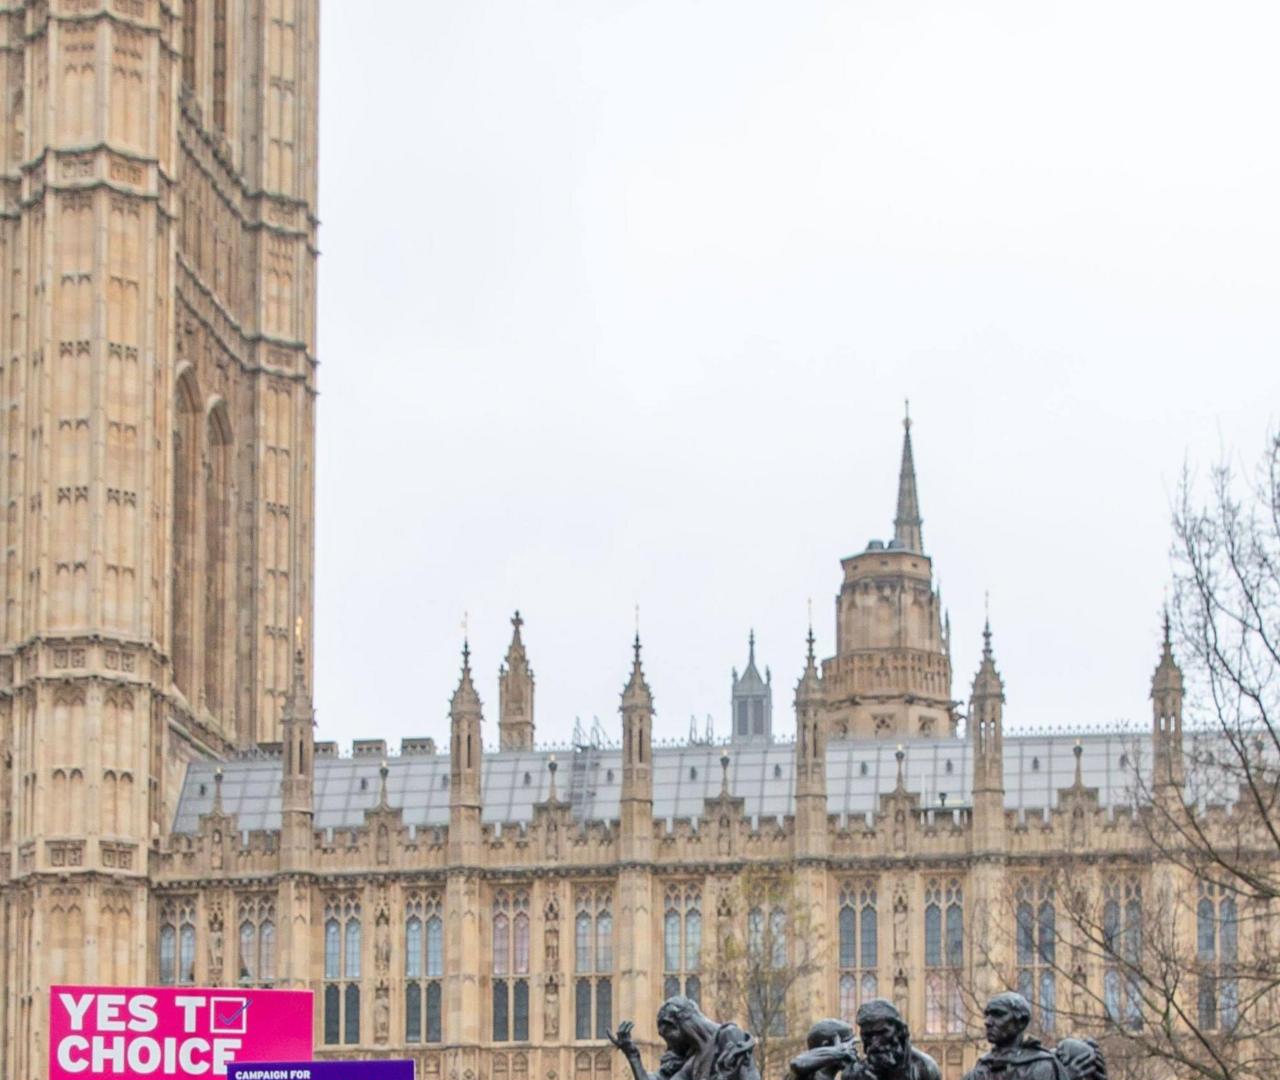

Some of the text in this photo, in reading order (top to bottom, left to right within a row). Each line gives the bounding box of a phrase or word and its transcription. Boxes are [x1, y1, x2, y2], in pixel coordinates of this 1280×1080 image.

[59, 993, 158, 1032] YES
[235, 1070, 311, 1080] CAMPAIGN FOR
